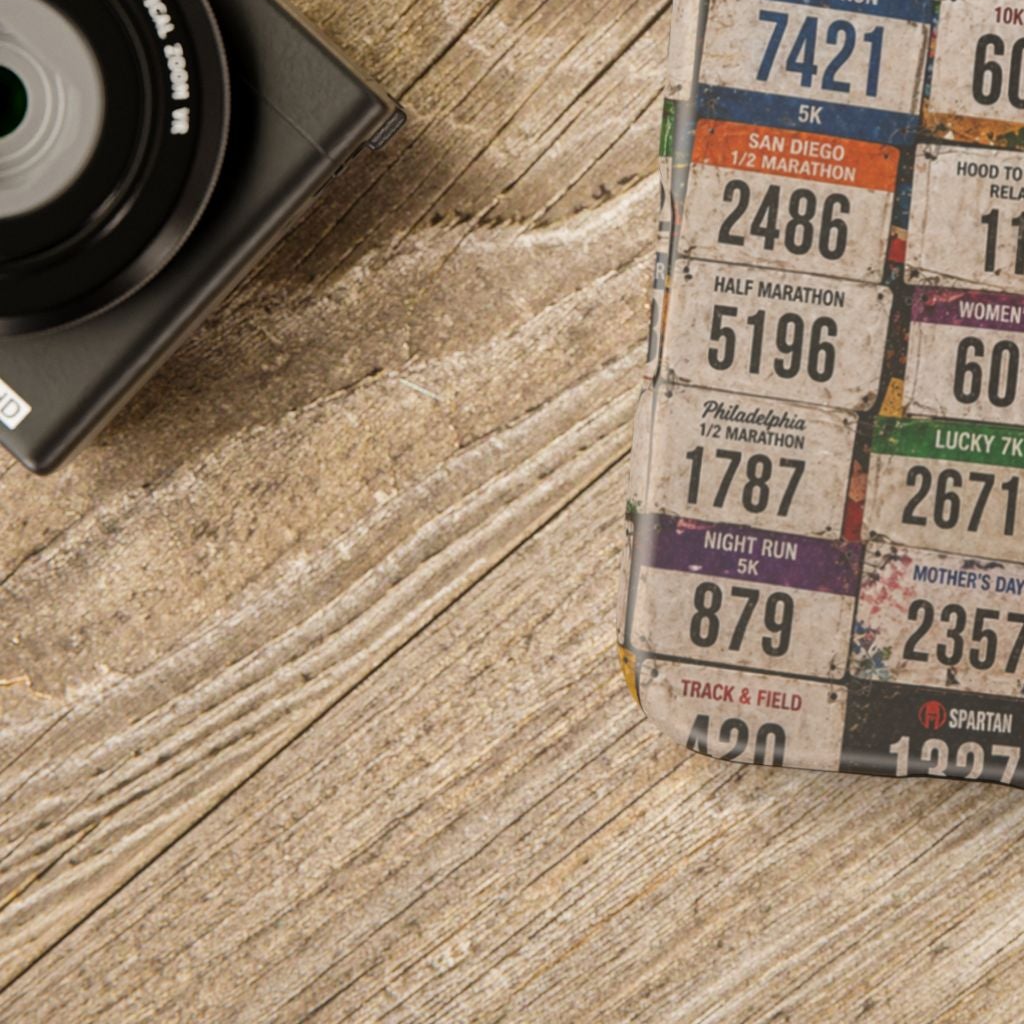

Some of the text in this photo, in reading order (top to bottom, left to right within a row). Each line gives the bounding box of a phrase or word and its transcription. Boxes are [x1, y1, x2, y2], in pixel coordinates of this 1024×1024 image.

[755, 9, 885, 98] 7421
[163, 42, 190, 101] ZOOM
[797, 104, 823, 125] 5K
[748, 132, 846, 162] SAN DIEGO
[730, 150, 857, 182] 1/2 MARATHON
[956, 160, 1000, 180] HOOD
[1003, 165, 1023, 182] TO
[717, 179, 851, 262] 2486
[713, 275, 846, 308] HALF MARATHON
[707, 304, 838, 383] 5196
[701, 399, 807, 432] Philadelphia
[699, 423, 805, 450] 1/2 MARATHON
[934, 429, 1024, 457] LUCKY 7K
[685, 445, 806, 518] 1787
[901, 464, 1020, 536] 2671
[704, 530, 799, 561] NIGHT RUN
[737, 558, 759, 576] 5K
[912, 564, 991, 591] MOTHER'S
[689, 581, 795, 658] 879
[681, 678, 803, 712] TRACK & FIELD
[948, 707, 1013, 734] SPARTAN
